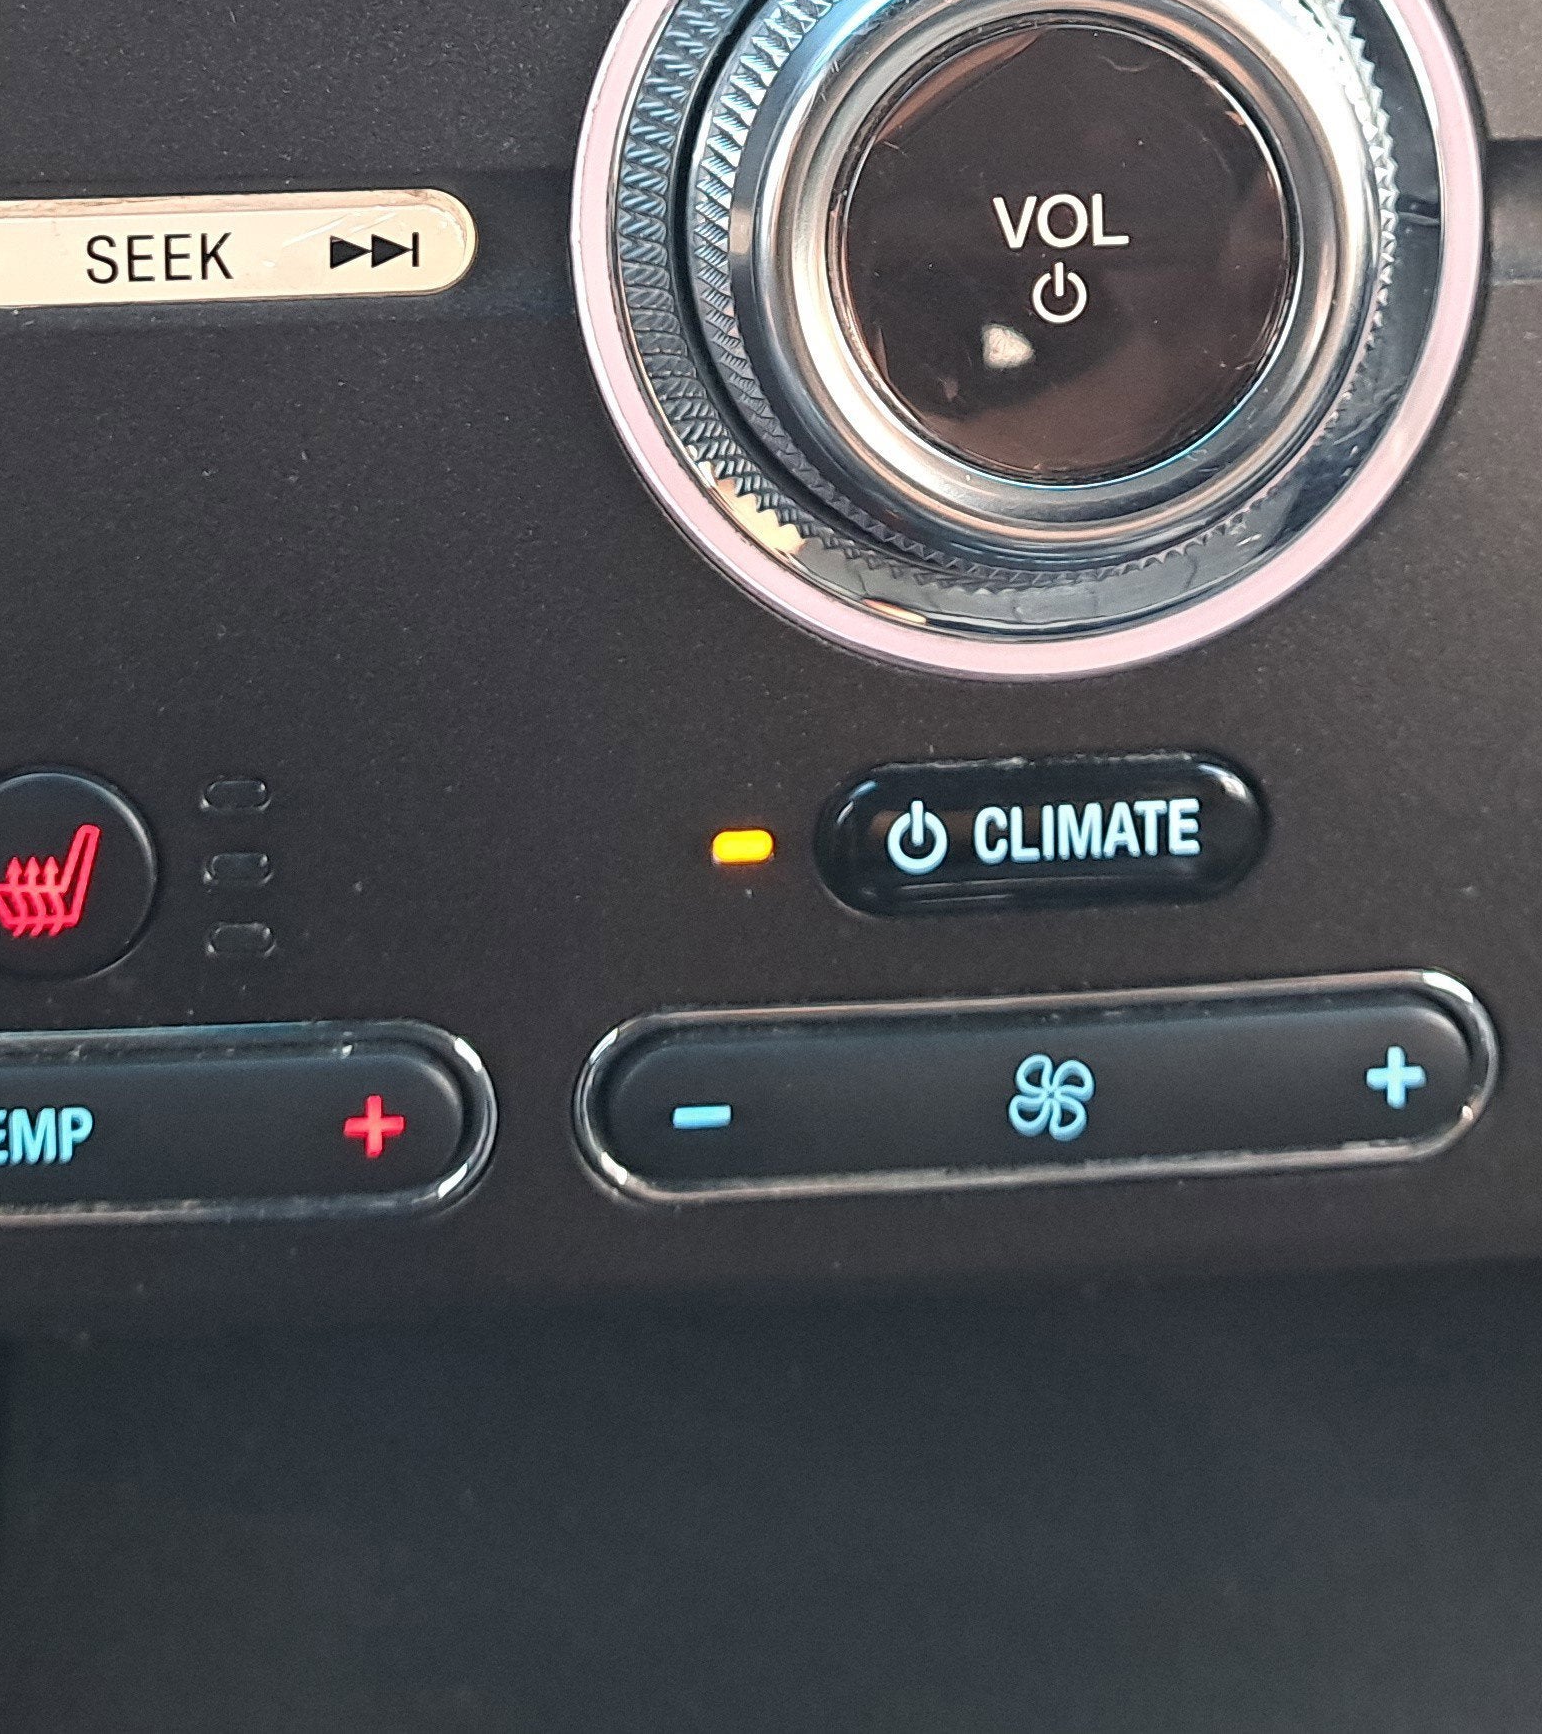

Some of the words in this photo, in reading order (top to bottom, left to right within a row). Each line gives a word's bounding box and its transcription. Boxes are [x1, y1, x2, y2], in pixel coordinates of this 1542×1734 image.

[992, 192, 1130, 250] VOL
[86, 232, 234, 284] SEEK
[973, 797, 1202, 865] CLIMATE
